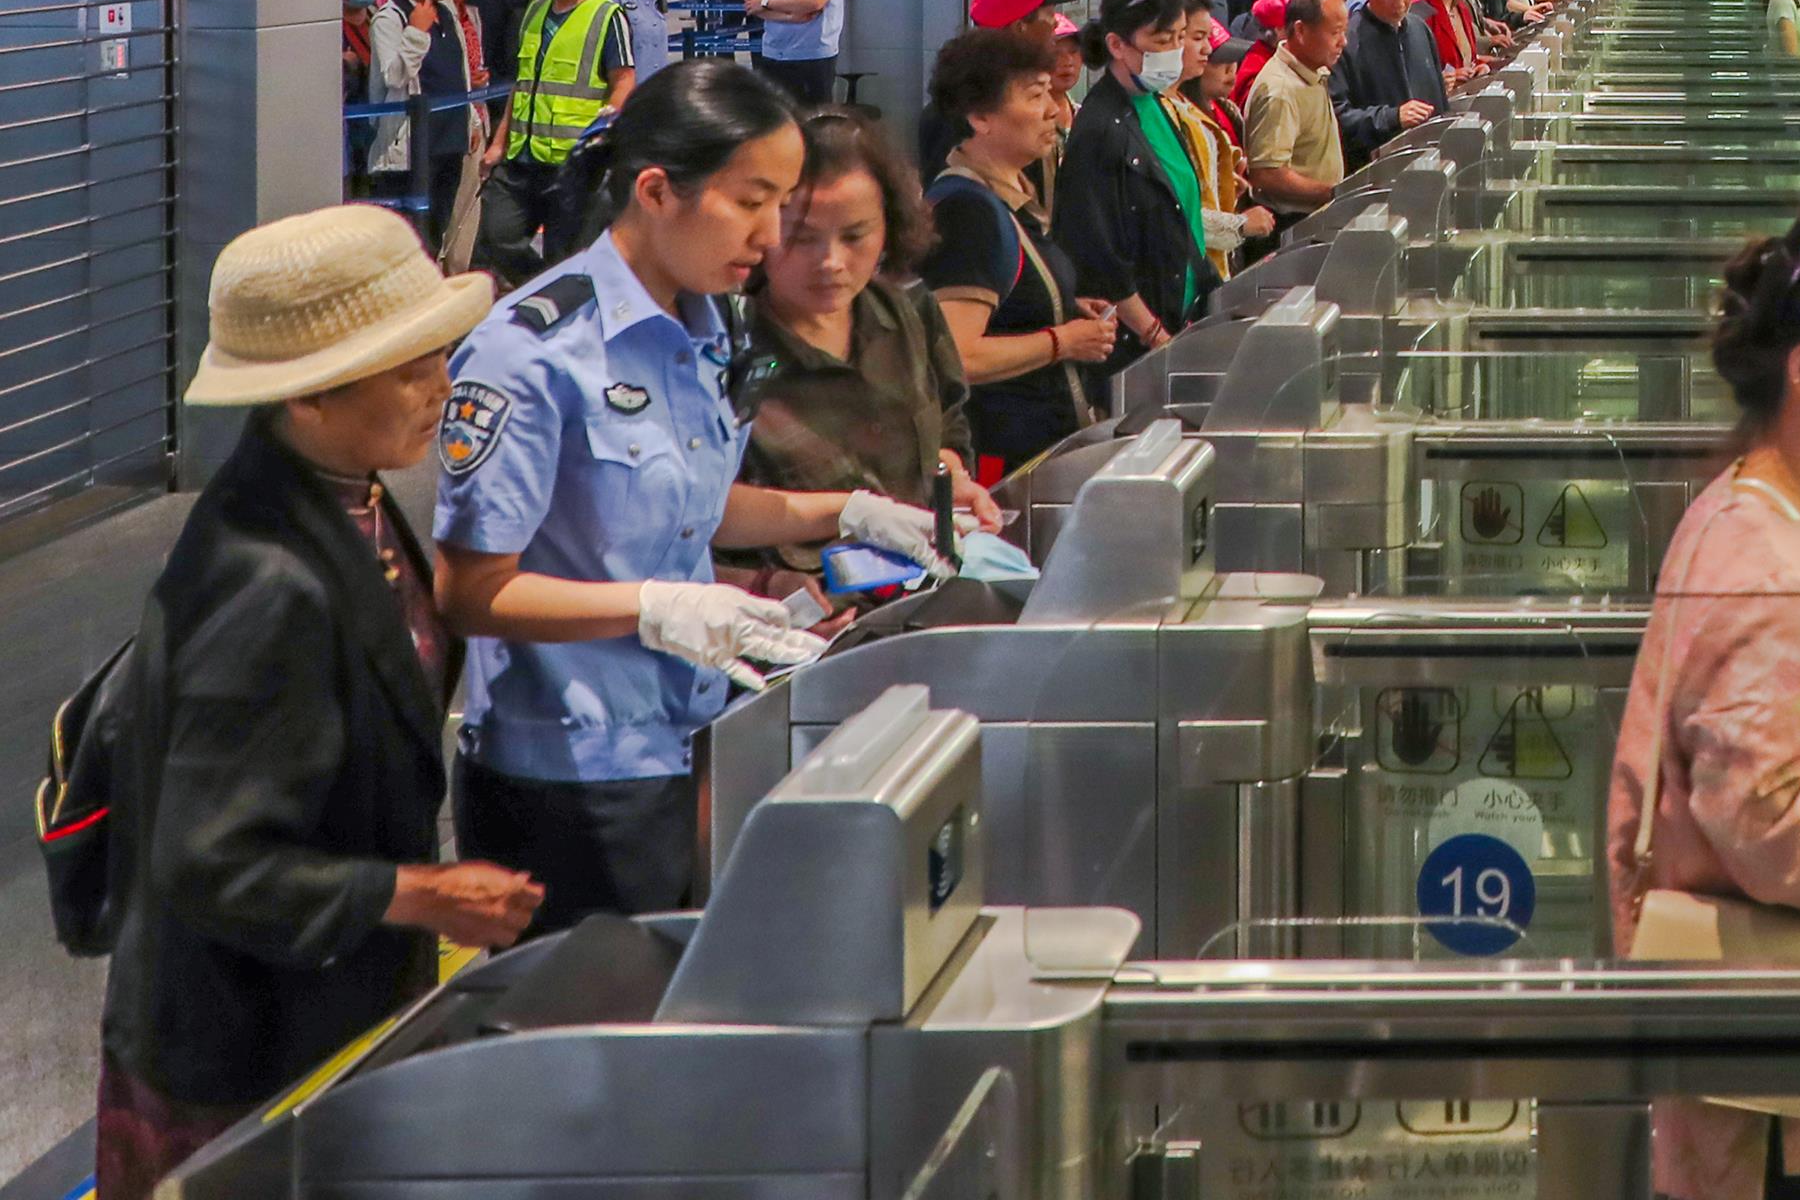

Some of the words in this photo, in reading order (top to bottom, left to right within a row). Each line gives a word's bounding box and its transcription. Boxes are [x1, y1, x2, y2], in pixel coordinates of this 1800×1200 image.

[1483, 788, 1565, 811] 小心夹手
[1474, 810, 1510, 821] Watch
[1512, 813, 1537, 824] your
[1441, 866, 1511, 925] 19
